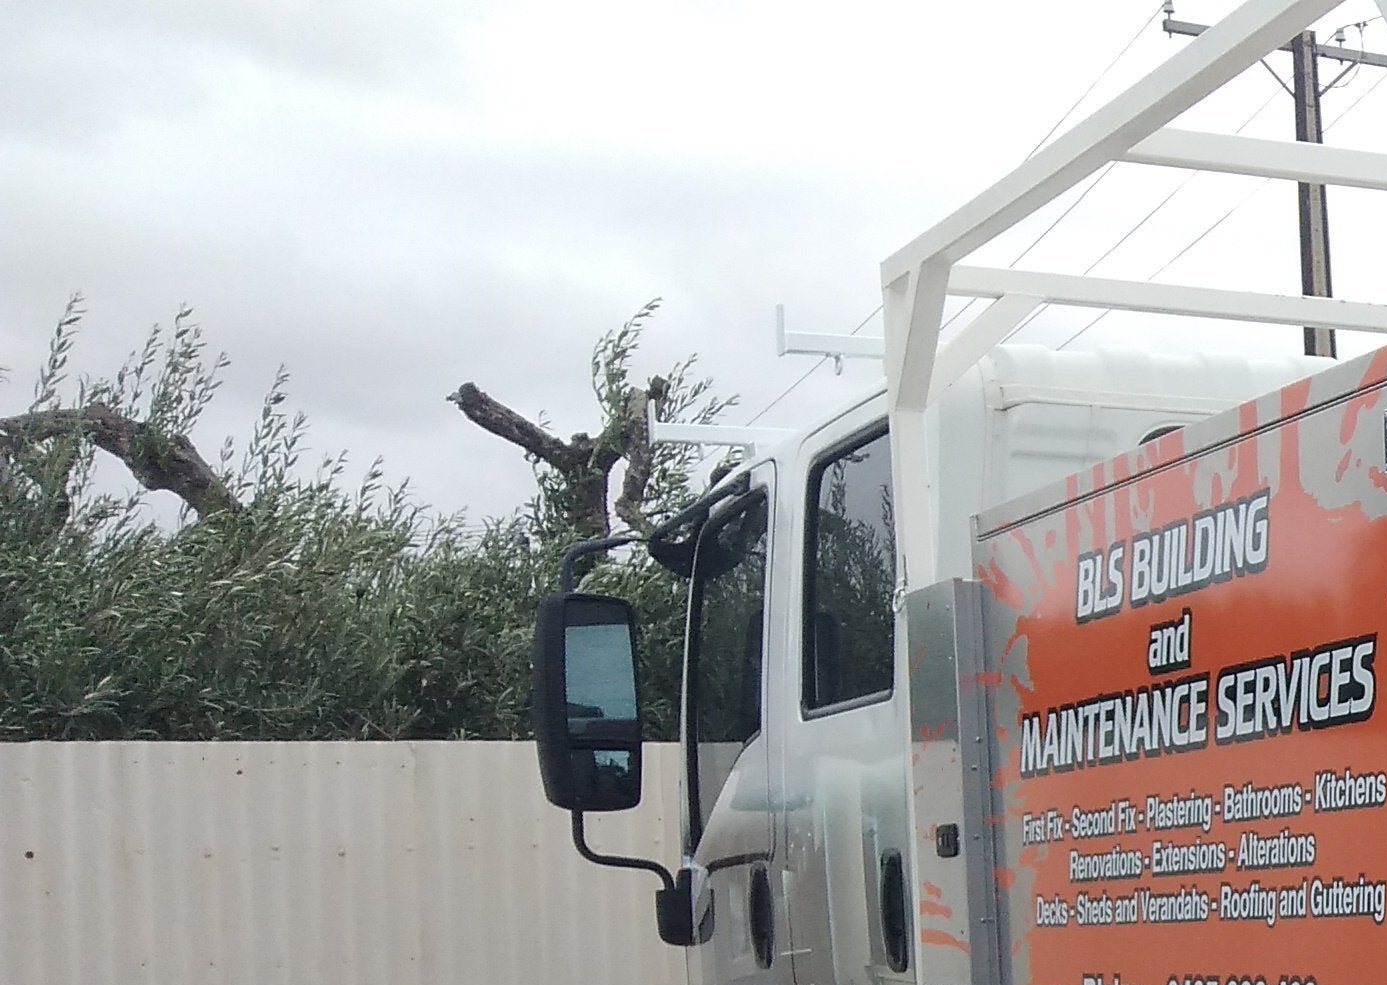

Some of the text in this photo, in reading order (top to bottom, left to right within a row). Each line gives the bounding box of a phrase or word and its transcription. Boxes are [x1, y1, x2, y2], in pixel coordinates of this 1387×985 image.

[1077, 495, 1268, 618] BLS BUILDING
[1148, 614, 1190, 668] and
[1020, 641, 1374, 773] MAINTENANCE SERVICES
[1315, 770, 1387, 810] Kitchens
[1022, 814, 1045, 843] First
[1046, 811, 1063, 840] Fix
[1071, 803, 1115, 838] Second
[1117, 800, 1136, 832] Fix
[1146, 792, 1212, 831] Plastering
[1224, 784, 1302, 820] Bathrooms
[1069, 846, 1142, 879] Renovations
[1152, 842, 1226, 873] Extensions
[1237, 830, 1315, 866] Alterations
[1036, 896, 1068, 925] Decks
[1076, 894, 1113, 924] Sheds
[1115, 892, 1138, 923] and
[1140, 888, 1209, 921] Verandahs
[1220, 883, 1277, 925] Roofing
[1279, 881, 1307, 917] and
[1310, 877, 1386, 922] Guttering
